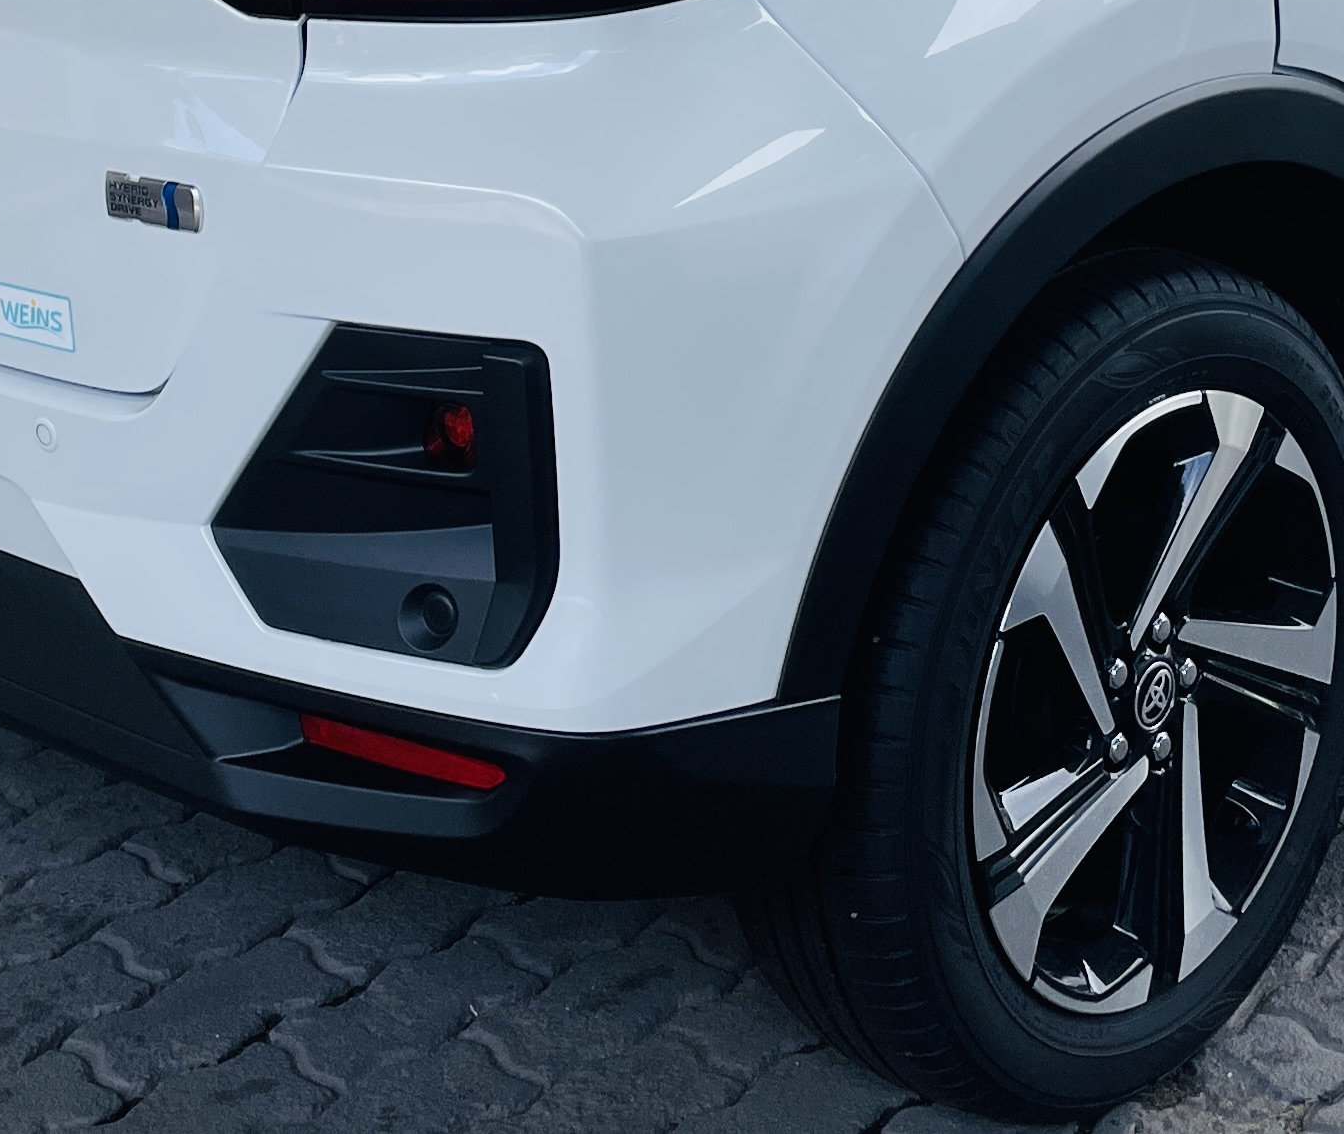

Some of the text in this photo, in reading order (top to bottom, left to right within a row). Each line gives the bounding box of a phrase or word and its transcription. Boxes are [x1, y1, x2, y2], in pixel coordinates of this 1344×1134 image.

[109, 180, 149, 196] HYBRID
[109, 191, 159, 209] SYNERGY
[110, 202, 142, 216] DRIVE
